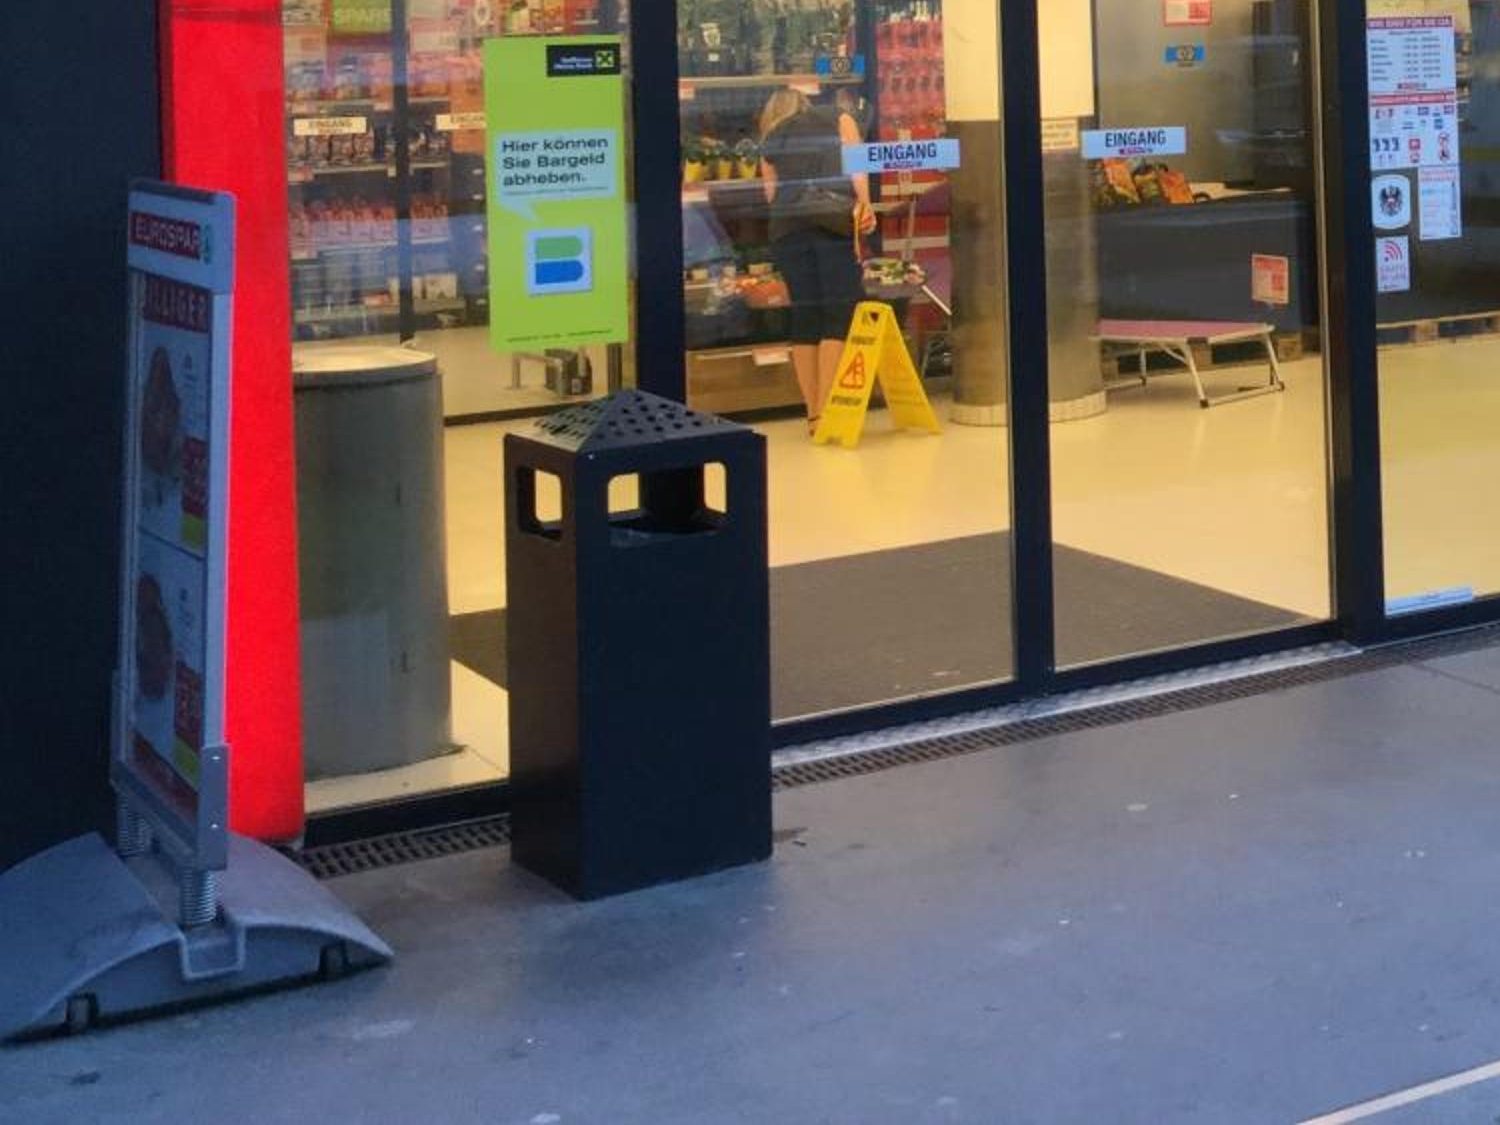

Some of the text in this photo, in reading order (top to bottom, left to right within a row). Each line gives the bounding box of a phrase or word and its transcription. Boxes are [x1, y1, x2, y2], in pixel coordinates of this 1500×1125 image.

[502, 135, 609, 153] Hier können
[1104, 130, 1167, 148] EINGANG
[503, 152, 606, 170] Sie Bargeld
[868, 142, 938, 162] EINGANG
[503, 171, 588, 187] abheben.
